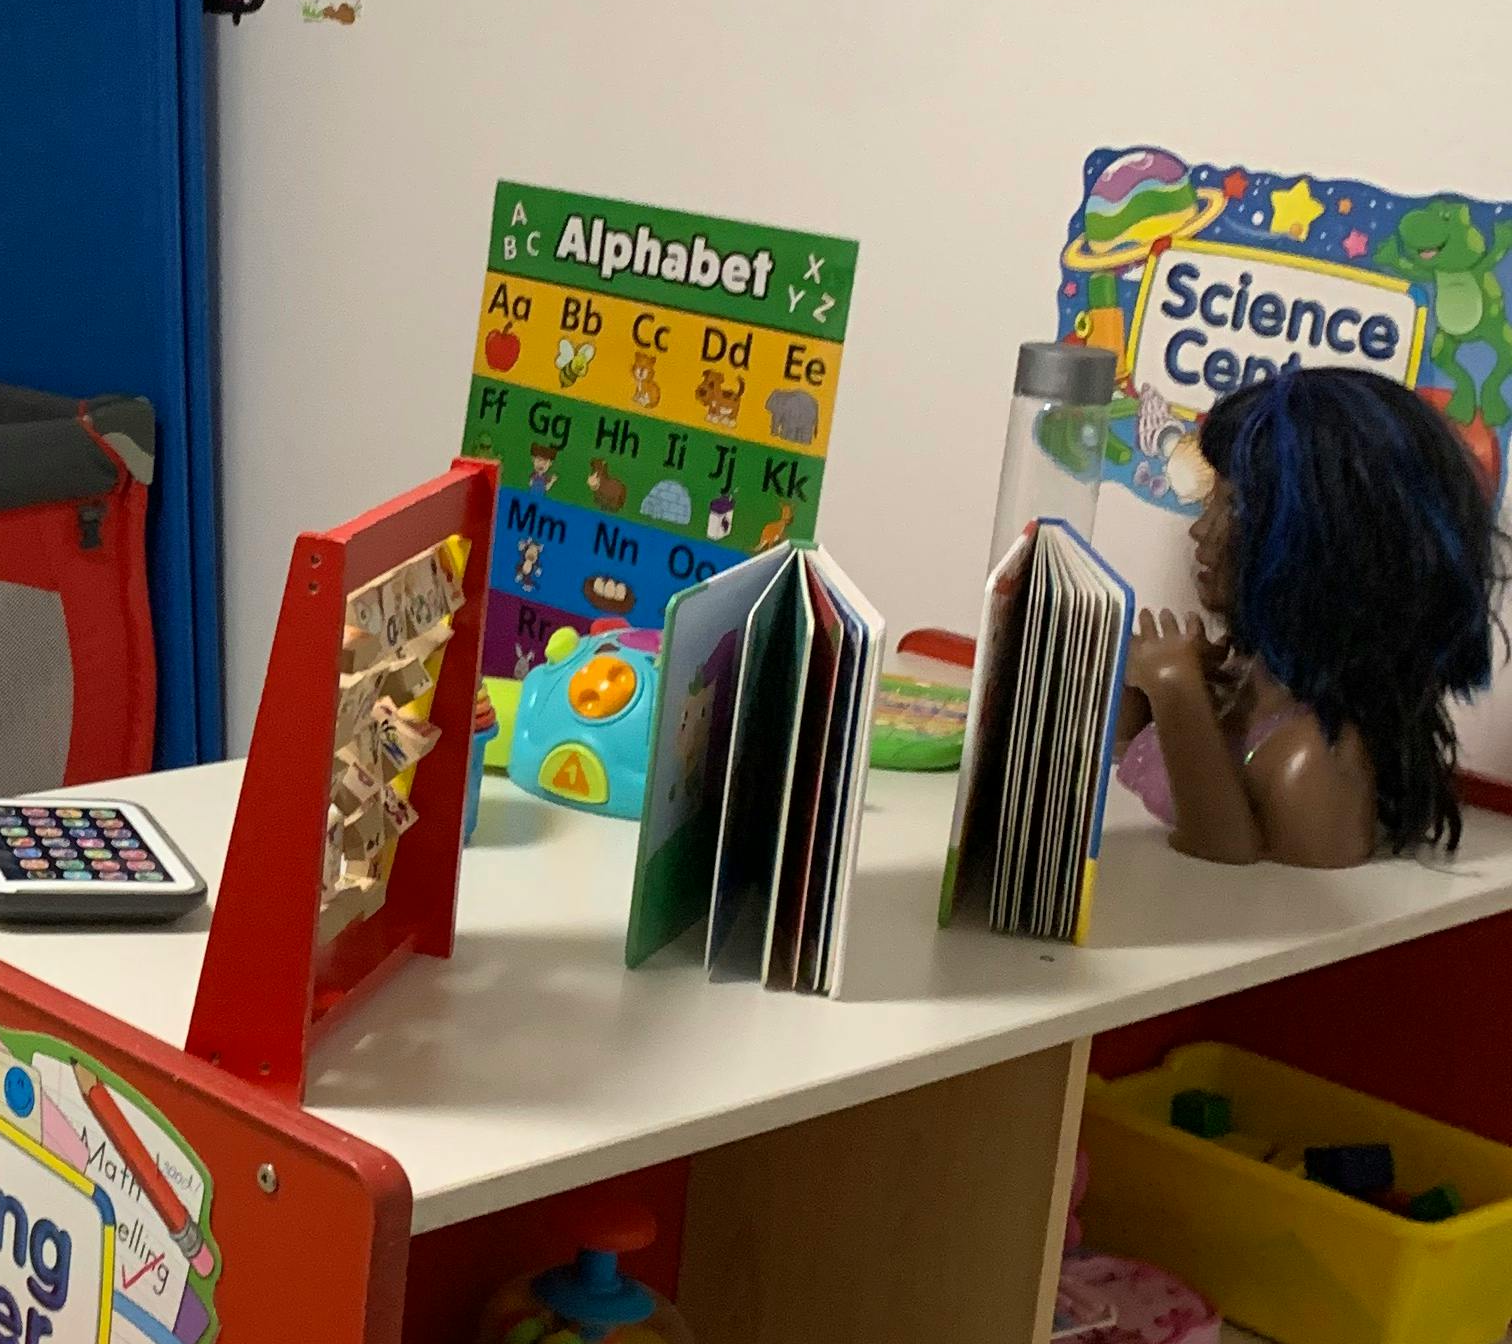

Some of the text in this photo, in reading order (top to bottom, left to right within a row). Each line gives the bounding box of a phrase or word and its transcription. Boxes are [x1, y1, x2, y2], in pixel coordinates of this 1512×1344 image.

[503, 231, 541, 261] B C
[511, 201, 527, 226] A
[554, 213, 774, 299] Alphabet
[803, 252, 825, 285] X
[488, 282, 827, 387] Aa Bb Cc Dd Ee
[788, 284, 836, 323] Y Z
[1161, 262, 1401, 360] Science
[479, 387, 809, 503] Ff Gg Hh Ii Jj Kk
[507, 499, 567, 544] Mm
[594, 522, 639, 566] Nn
